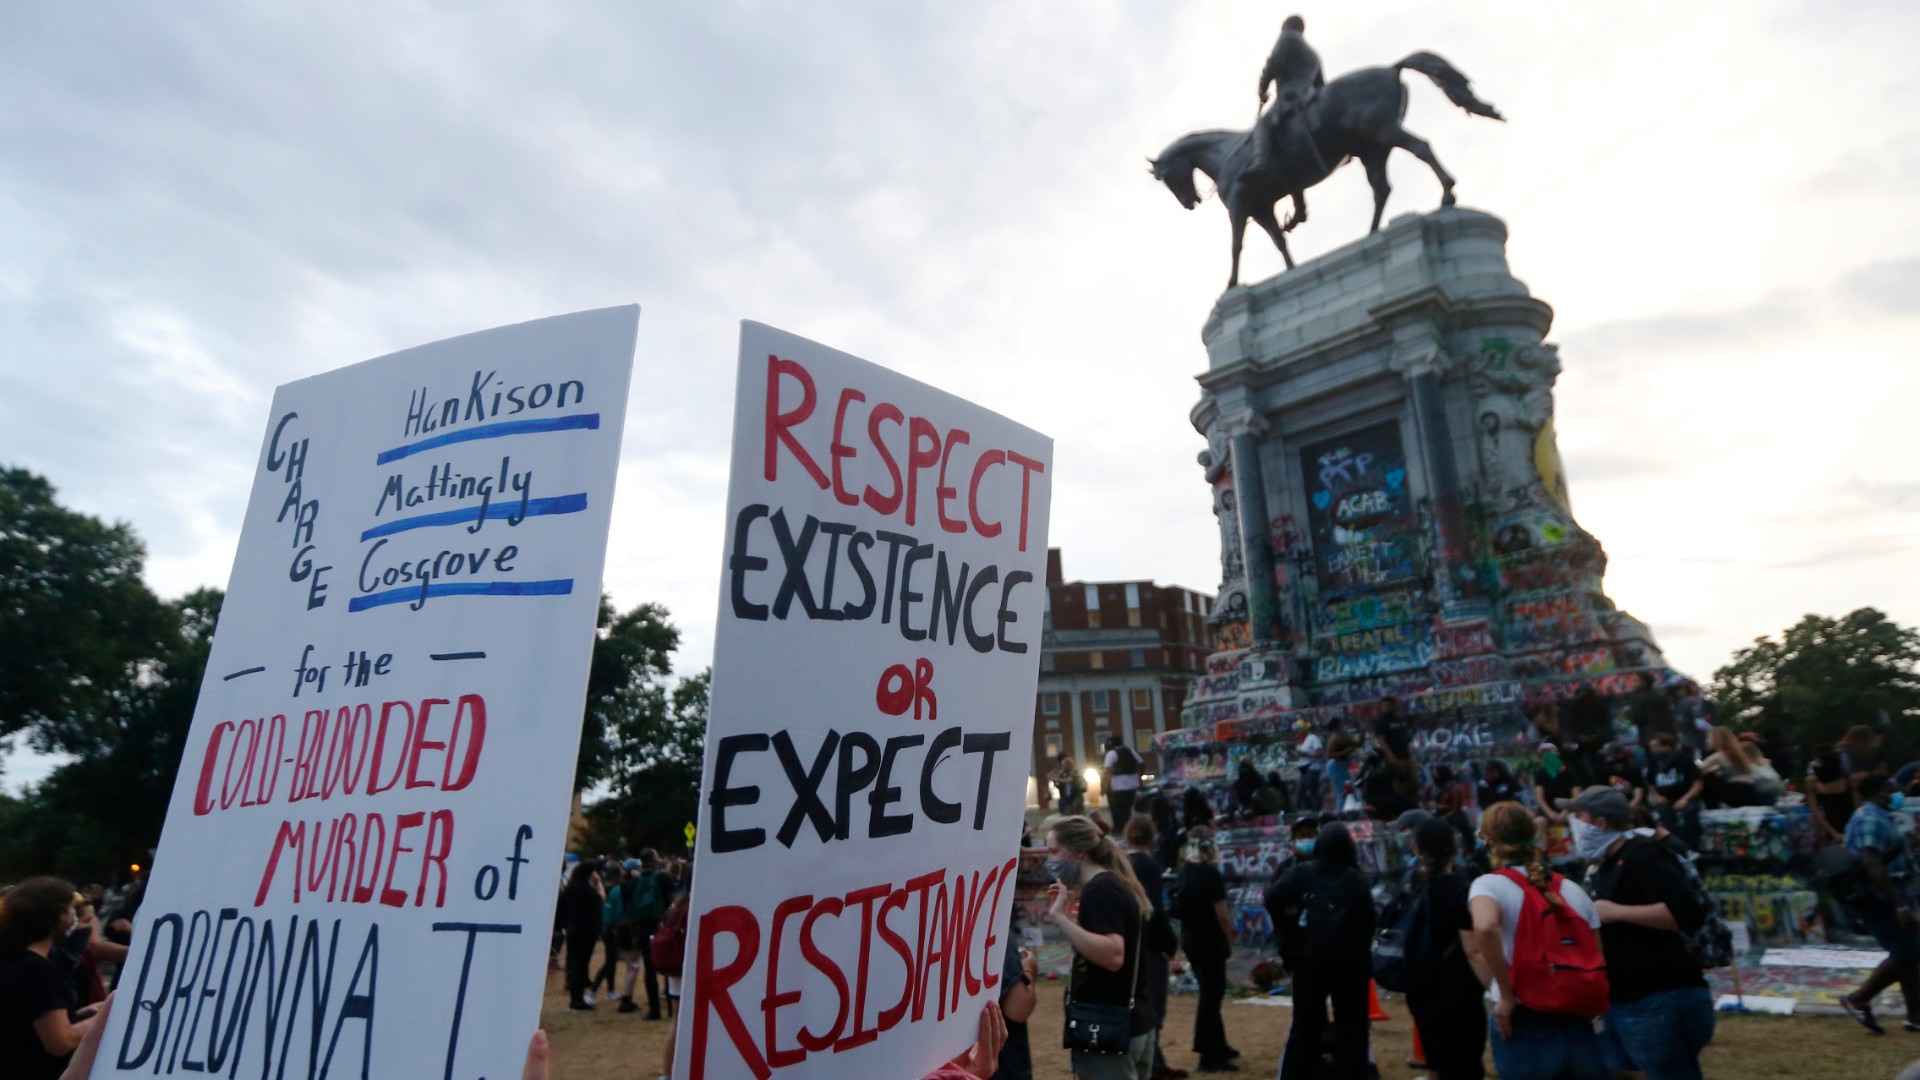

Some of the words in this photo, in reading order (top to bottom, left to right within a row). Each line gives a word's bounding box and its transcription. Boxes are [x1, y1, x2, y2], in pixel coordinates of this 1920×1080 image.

[375, 456, 532, 534] Mattingly
[764, 354, 1045, 552] RESPECT
[1336, 489, 1390, 518] ACAB
[267, 411, 333, 611] CHARGE
[359, 538, 518, 611] Cosgrove
[729, 503, 1034, 654] EXISTENCE
[293, 645, 331, 698] for
[342, 651, 393, 688] the
[876, 657, 938, 720] OR
[1482, 683, 1525, 705] BLM
[194, 693, 487, 816] COLD-BLOODED
[709, 726, 1011, 853] EXPECT
[254, 808, 454, 908] MURDER
[474, 824, 533, 900] of
[116, 908, 380, 1080] BREONNA
[690, 857, 1018, 1080] RESISTANCE
